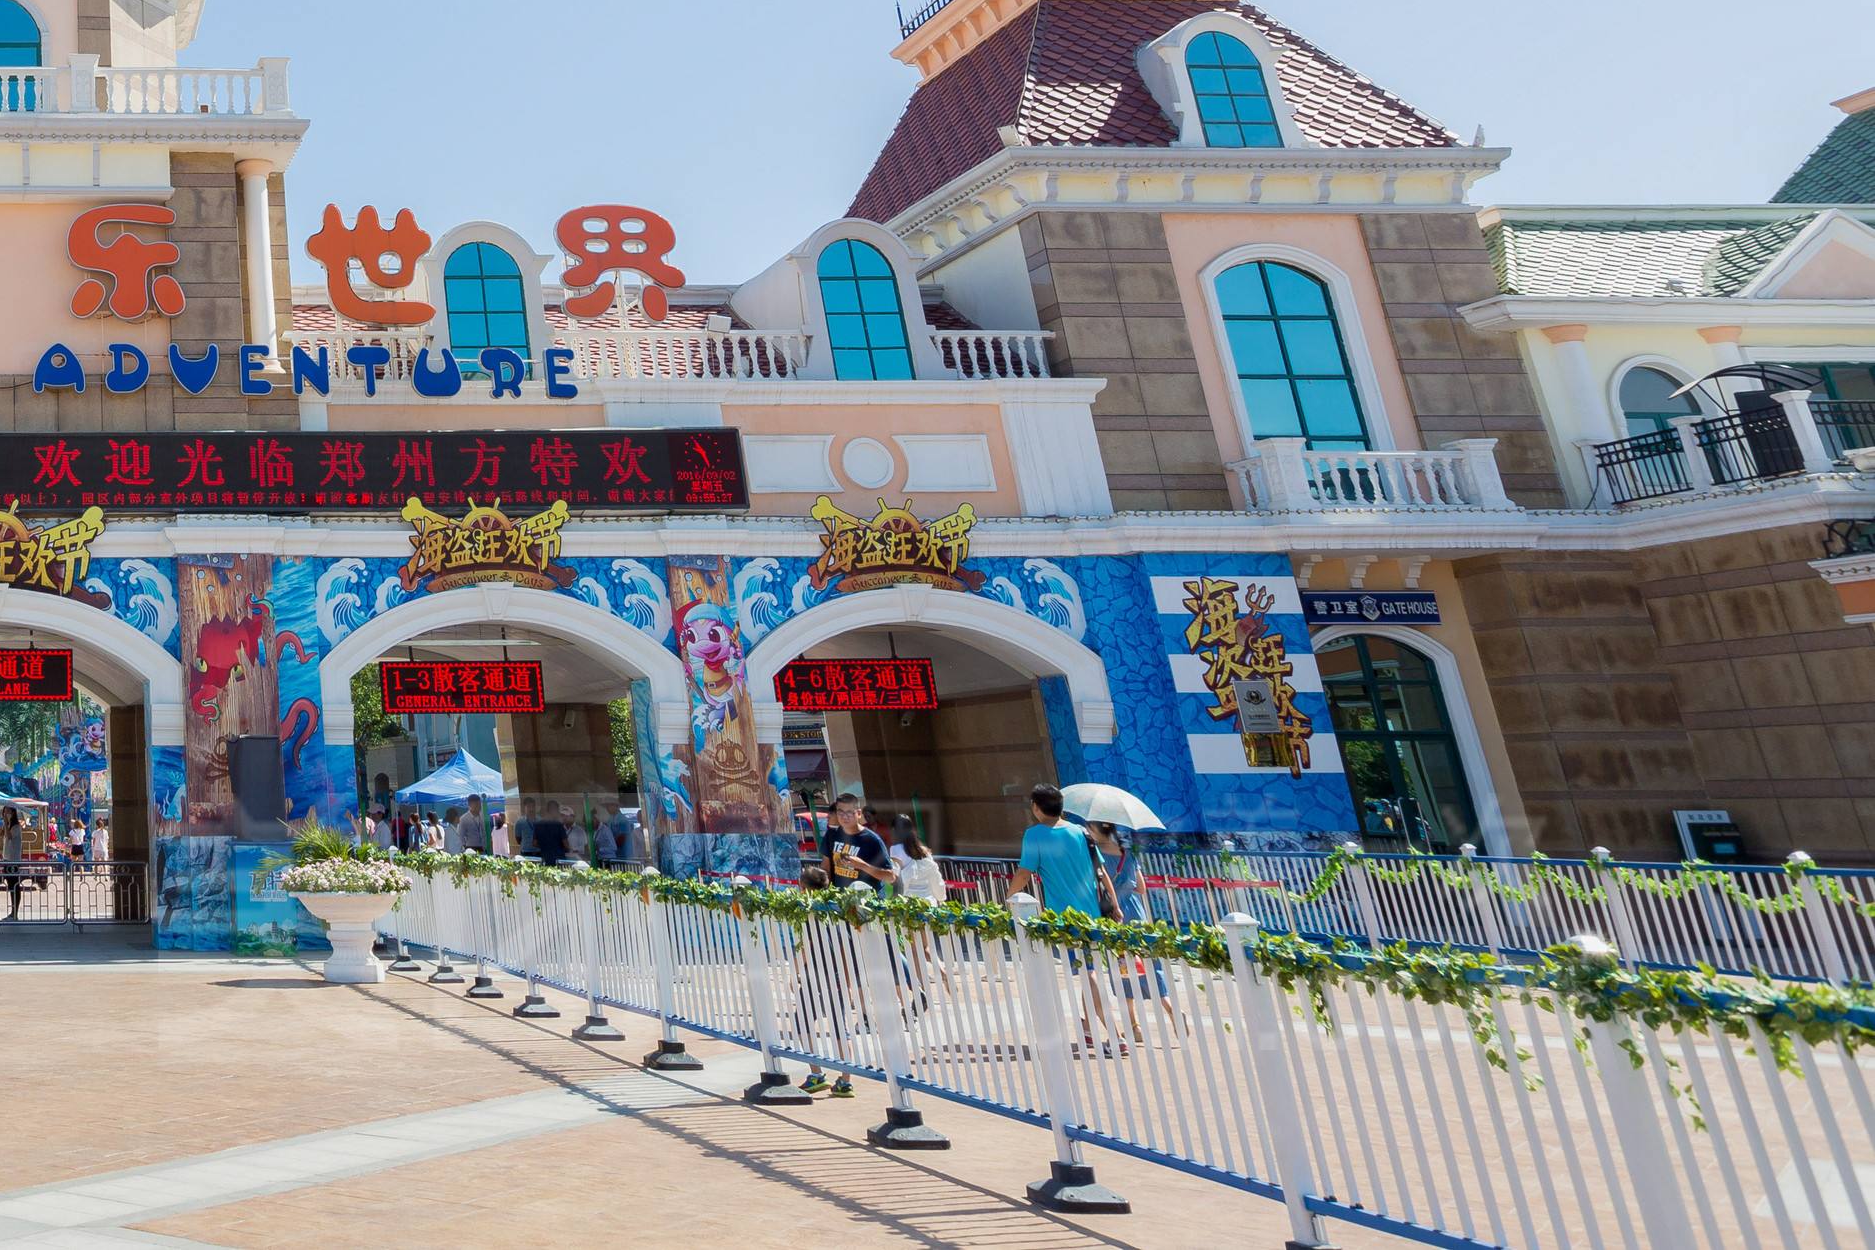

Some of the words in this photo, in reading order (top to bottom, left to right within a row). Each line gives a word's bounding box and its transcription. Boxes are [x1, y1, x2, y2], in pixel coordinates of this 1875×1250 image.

[32, 341, 579, 399] ADVENTURE
[33, 437, 652, 488] 欢迎光临郑州方特欢
[407, 512, 566, 583] 海盗狂欢节
[816, 515, 973, 582] 海盗狂欢节
[440, 572, 498, 590] Buccaneer
[851, 573, 906, 591] Buccaneer
[1313, 600, 1359, 615] 警卫室
[393, 666, 534, 693] 1-3散客通道
[784, 665, 925, 691] 4-6散客通道
[397, 695, 456, 708] GENERAL
[464, 694, 532, 707] ENTRANCE
[833, 840, 861, 857] TEAM
